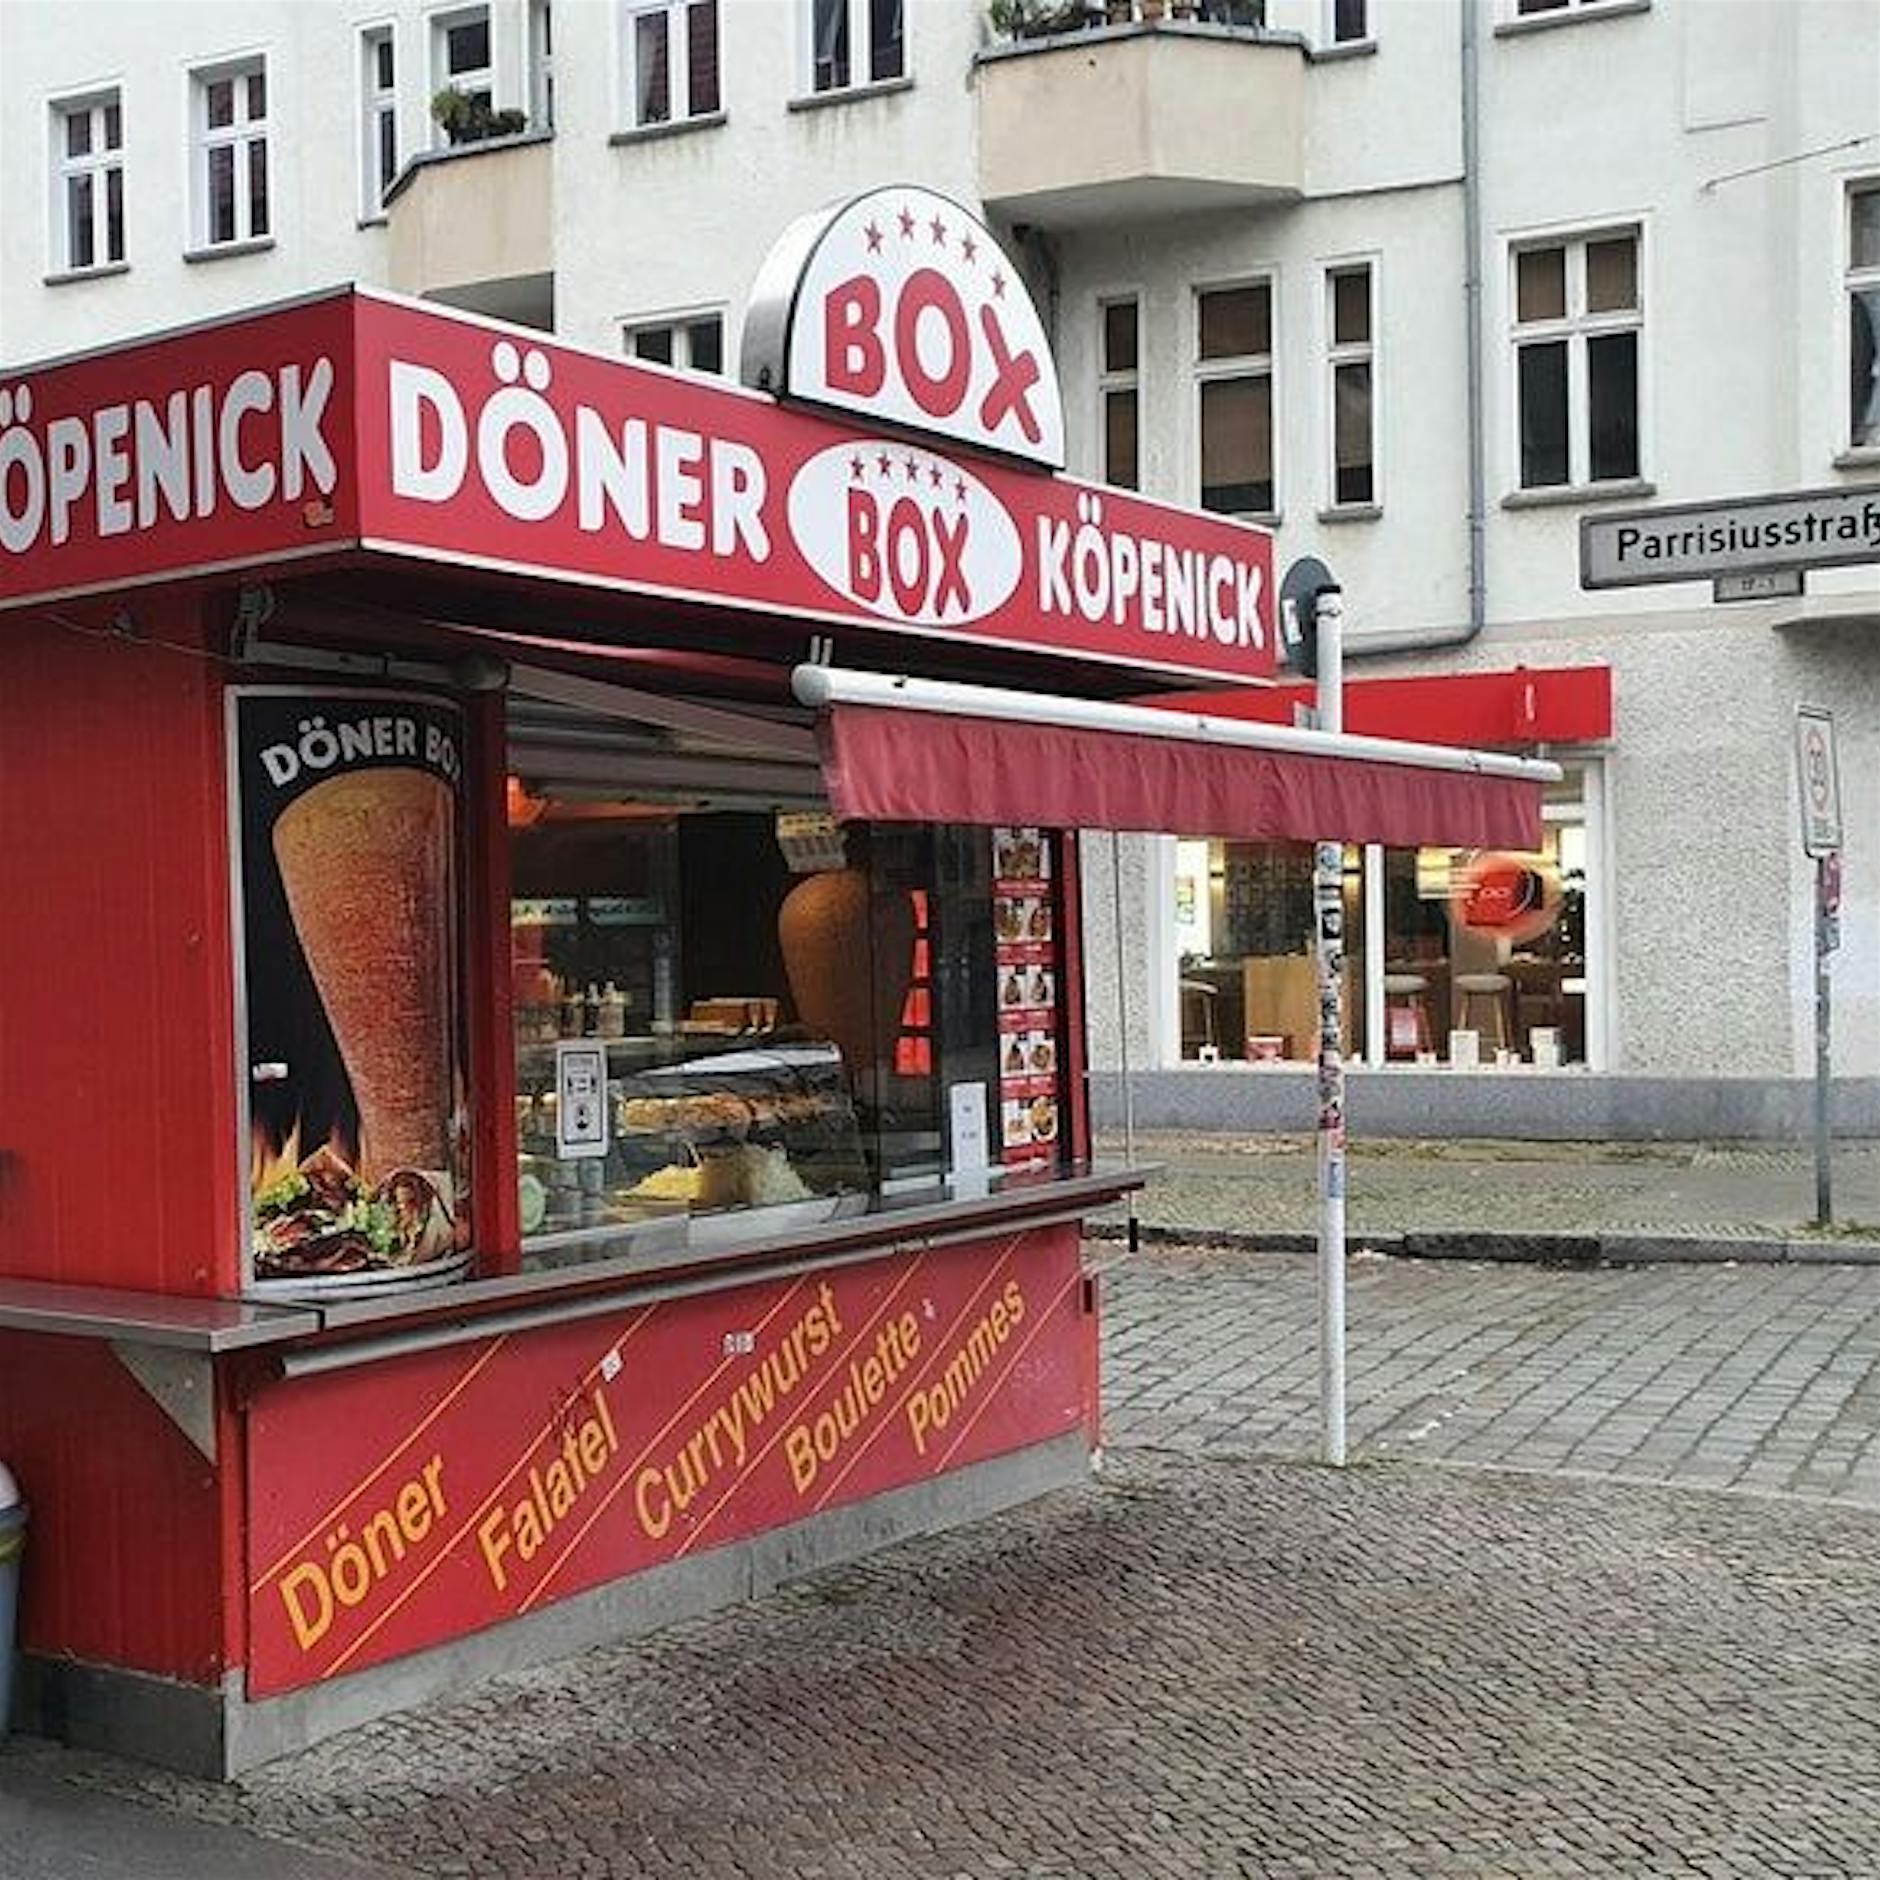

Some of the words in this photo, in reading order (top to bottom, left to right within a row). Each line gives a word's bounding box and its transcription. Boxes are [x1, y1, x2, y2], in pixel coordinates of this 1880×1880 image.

[825, 267, 1041, 444] BOX
[0, 356, 337, 553] ÖPENICK
[389, 341, 769, 563] DÖNER
[848, 487, 969, 617] BOX
[1037, 493, 1264, 649] KÖPENICK
[260, 716, 417, 787] DÖNER
[634, 1281, 844, 1539] Currywurst
[784, 1311, 922, 1494] Boulette
[906, 1279, 1027, 1456] Pommes
[278, 1454, 448, 1651] Döner
[478, 1388, 619, 1592] Falafel
